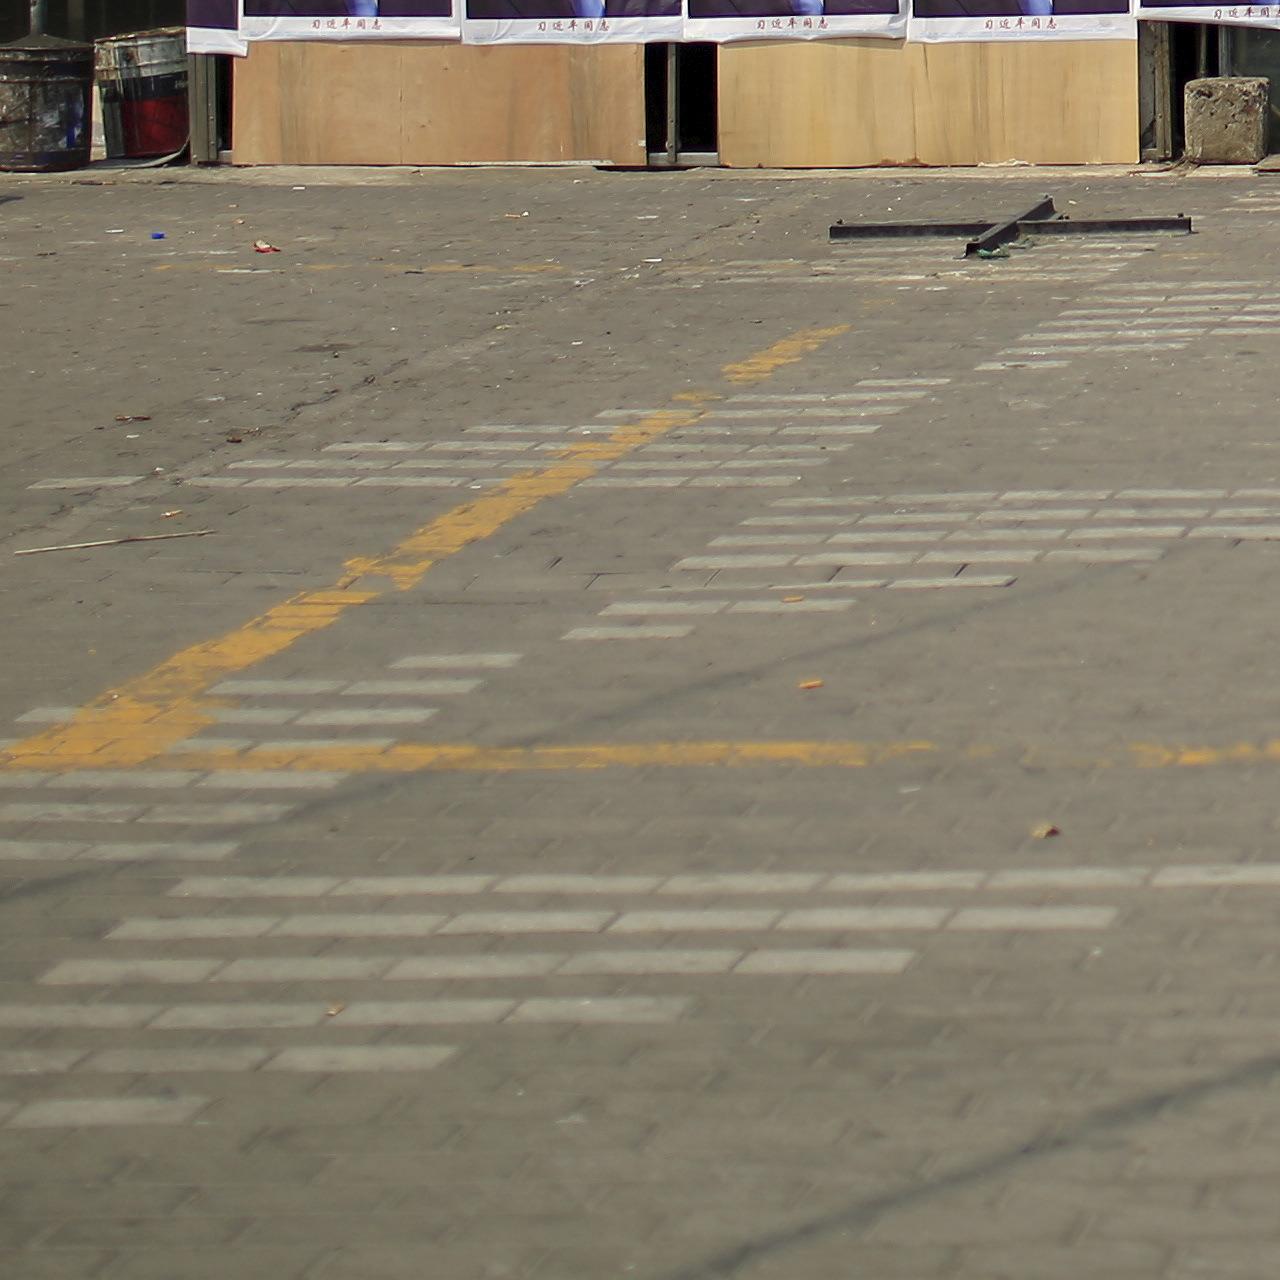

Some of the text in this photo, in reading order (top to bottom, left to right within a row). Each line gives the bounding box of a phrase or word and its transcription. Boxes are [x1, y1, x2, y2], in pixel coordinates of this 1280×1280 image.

[312, 17, 382, 31] 习近平同志
[538, 18, 611, 32] 习近平同志
[757, 16, 830, 30] 习近平同志
[985, 16, 1058, 30] 习近平同志
